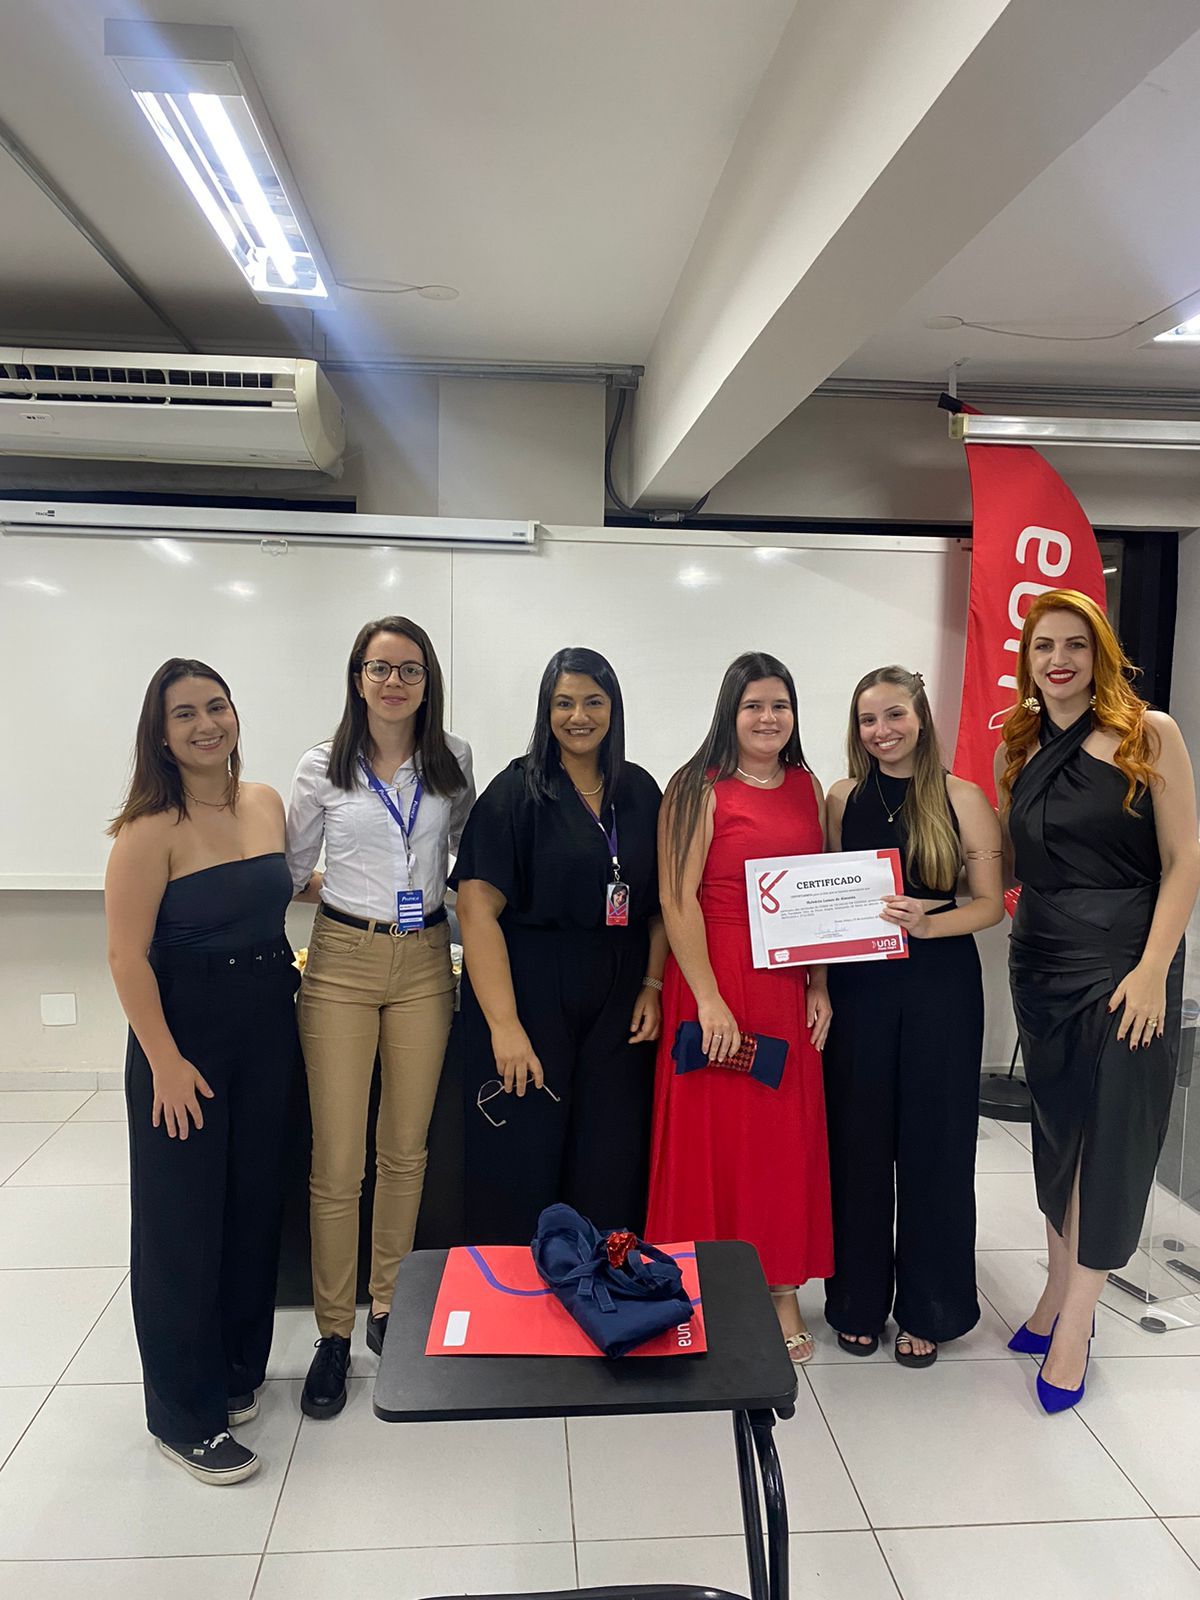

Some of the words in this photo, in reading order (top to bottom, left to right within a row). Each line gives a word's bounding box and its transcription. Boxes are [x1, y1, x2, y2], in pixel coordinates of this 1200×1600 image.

[796, 875, 862, 890] CERTIFICADO
[876, 938, 897, 948] una
[677, 1323, 692, 1347] una
